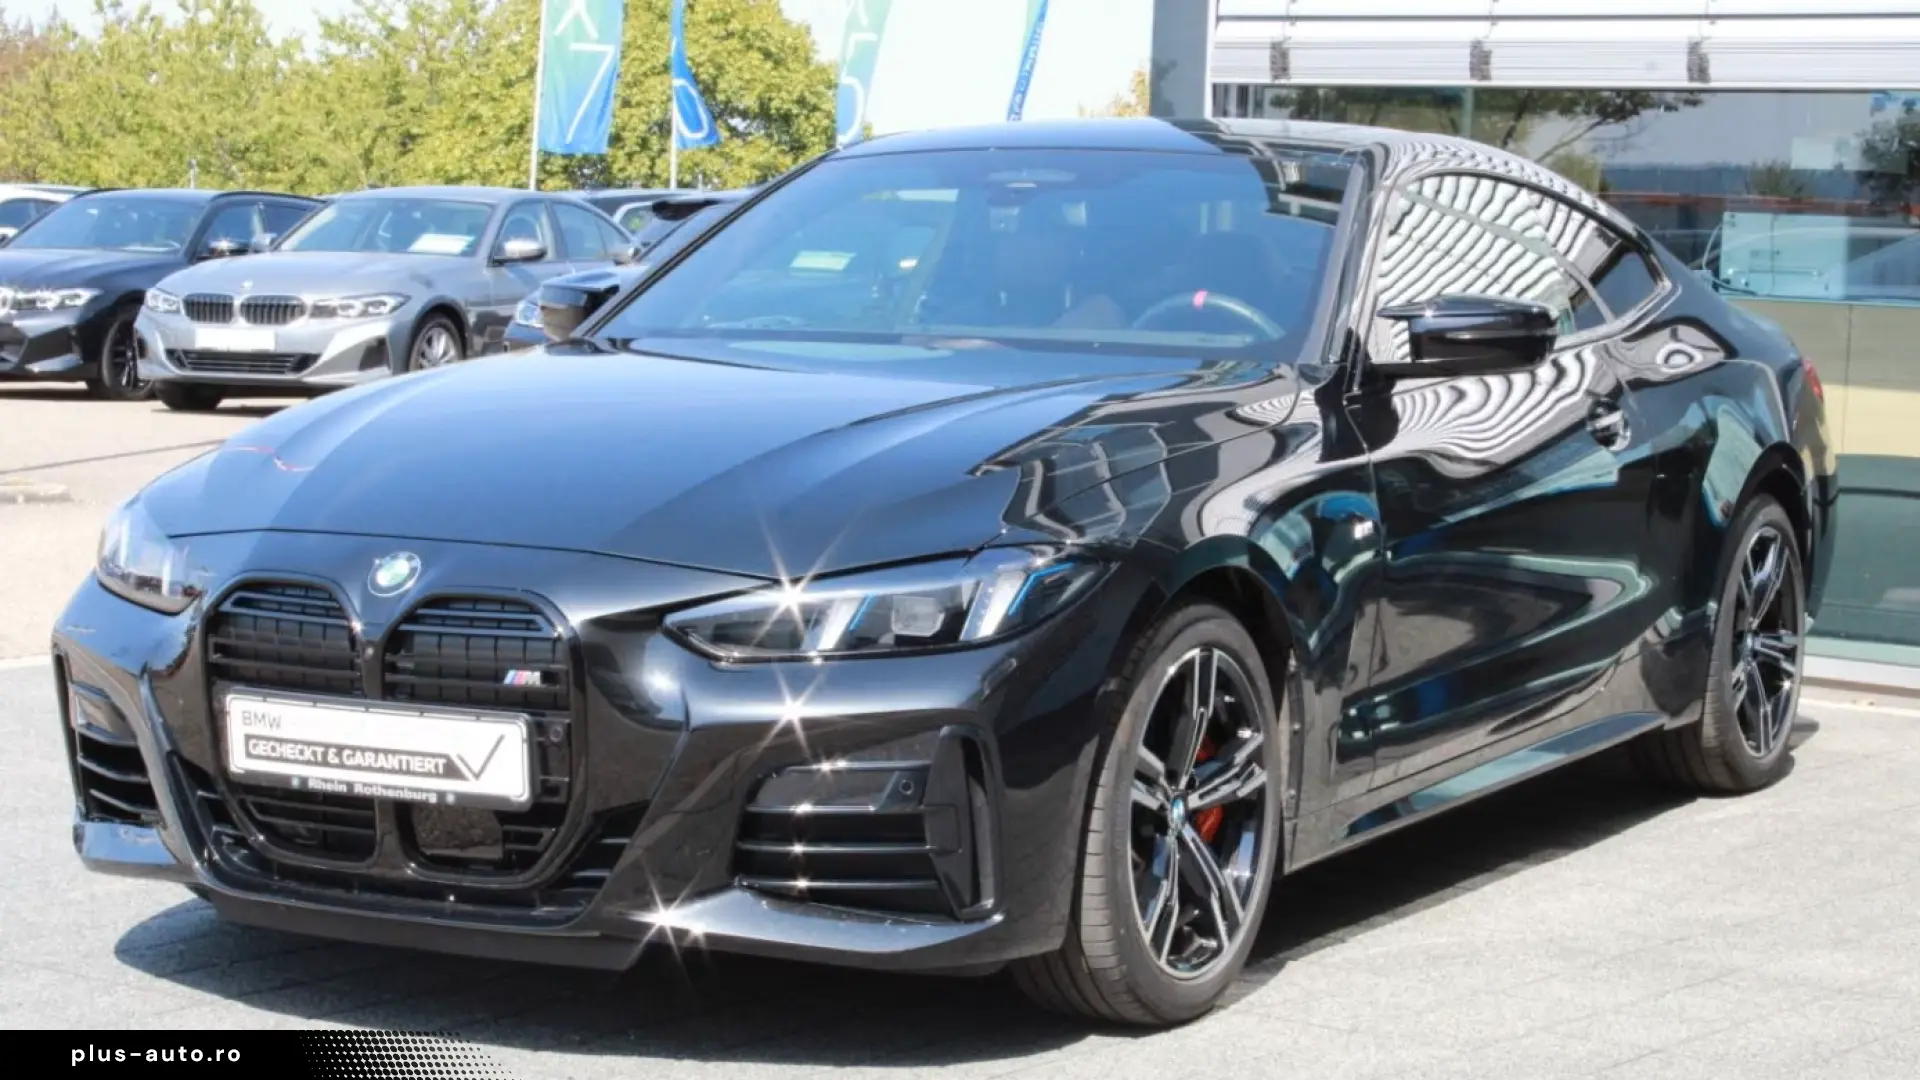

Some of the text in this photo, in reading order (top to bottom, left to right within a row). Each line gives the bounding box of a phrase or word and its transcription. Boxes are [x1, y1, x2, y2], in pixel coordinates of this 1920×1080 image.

[242, 711, 282, 730] BMW
[248, 738, 447, 775] GECHECKT & GARANTIERT
[308, 777, 438, 804] Rhein Rothenburg
